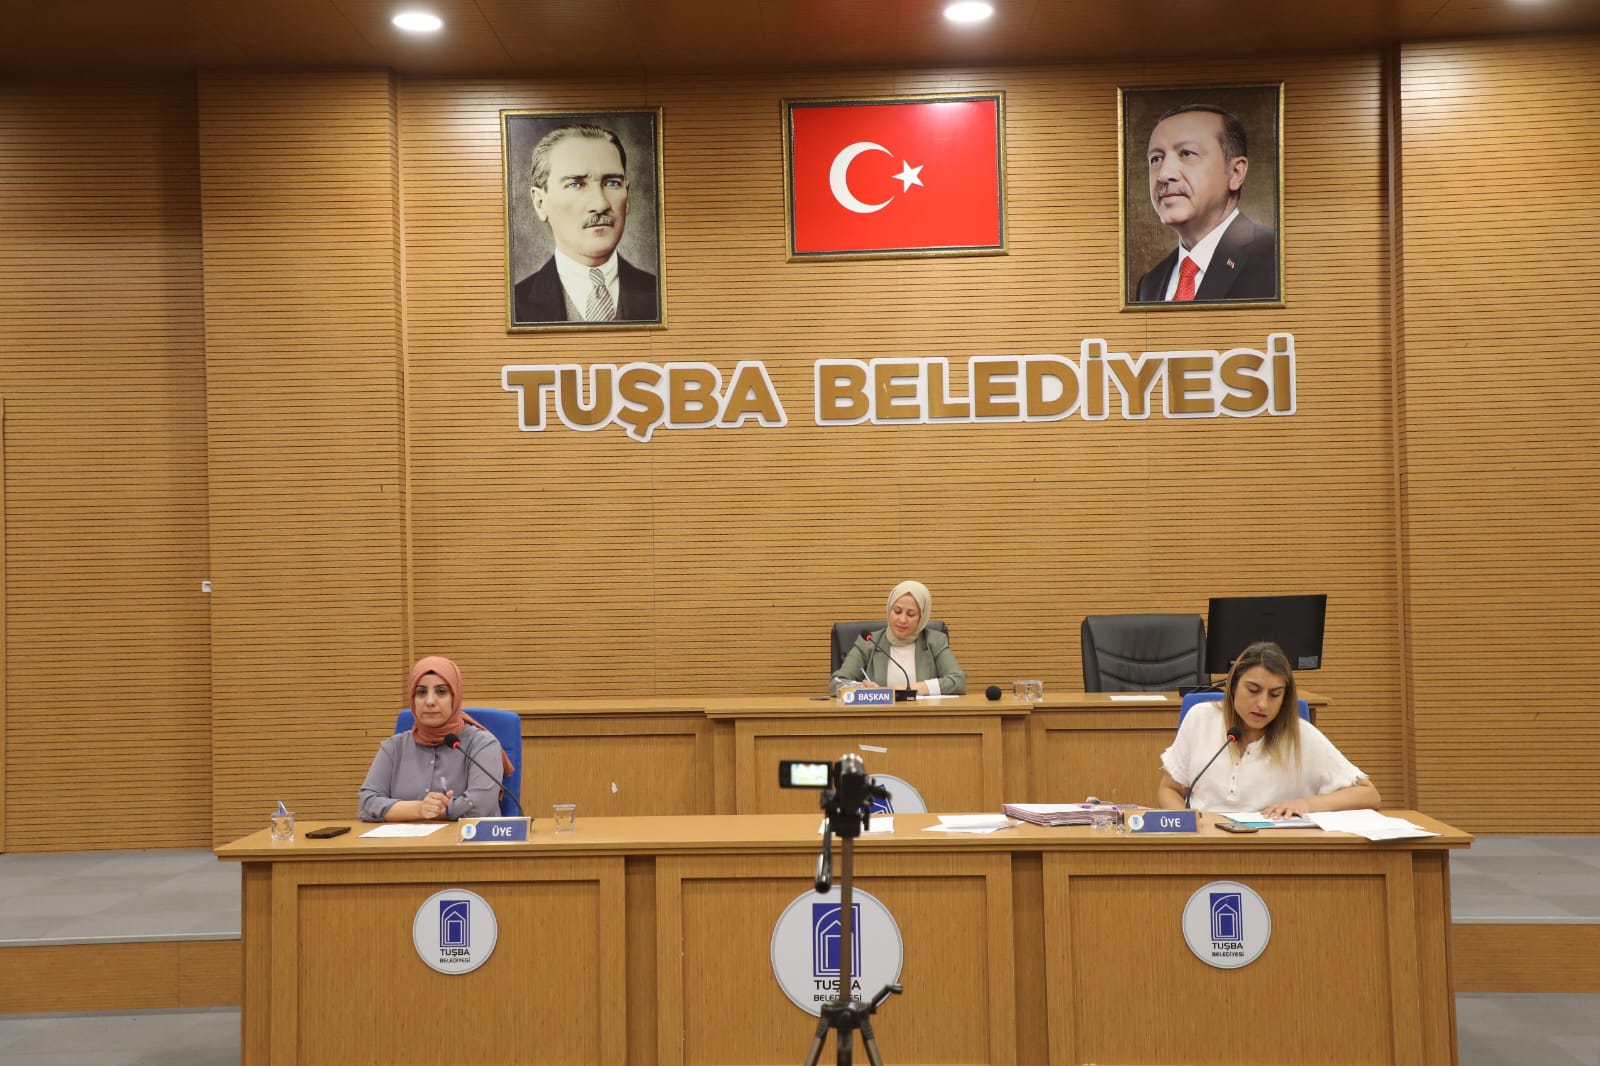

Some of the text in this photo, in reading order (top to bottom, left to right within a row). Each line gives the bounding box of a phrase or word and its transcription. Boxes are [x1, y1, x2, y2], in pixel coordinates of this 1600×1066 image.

[505, 335, 1295, 440] TUŞBA BELEDİYESİ
[858, 693, 890, 703] BAŞKAN
[1160, 816, 1182, 828] ÜYE
[491, 825, 512, 837] ÜYE
[440, 948, 470, 957] TUŞBA
[1212, 942, 1244, 951] TUŞBA
[813, 979, 861, 992] TUŞA
